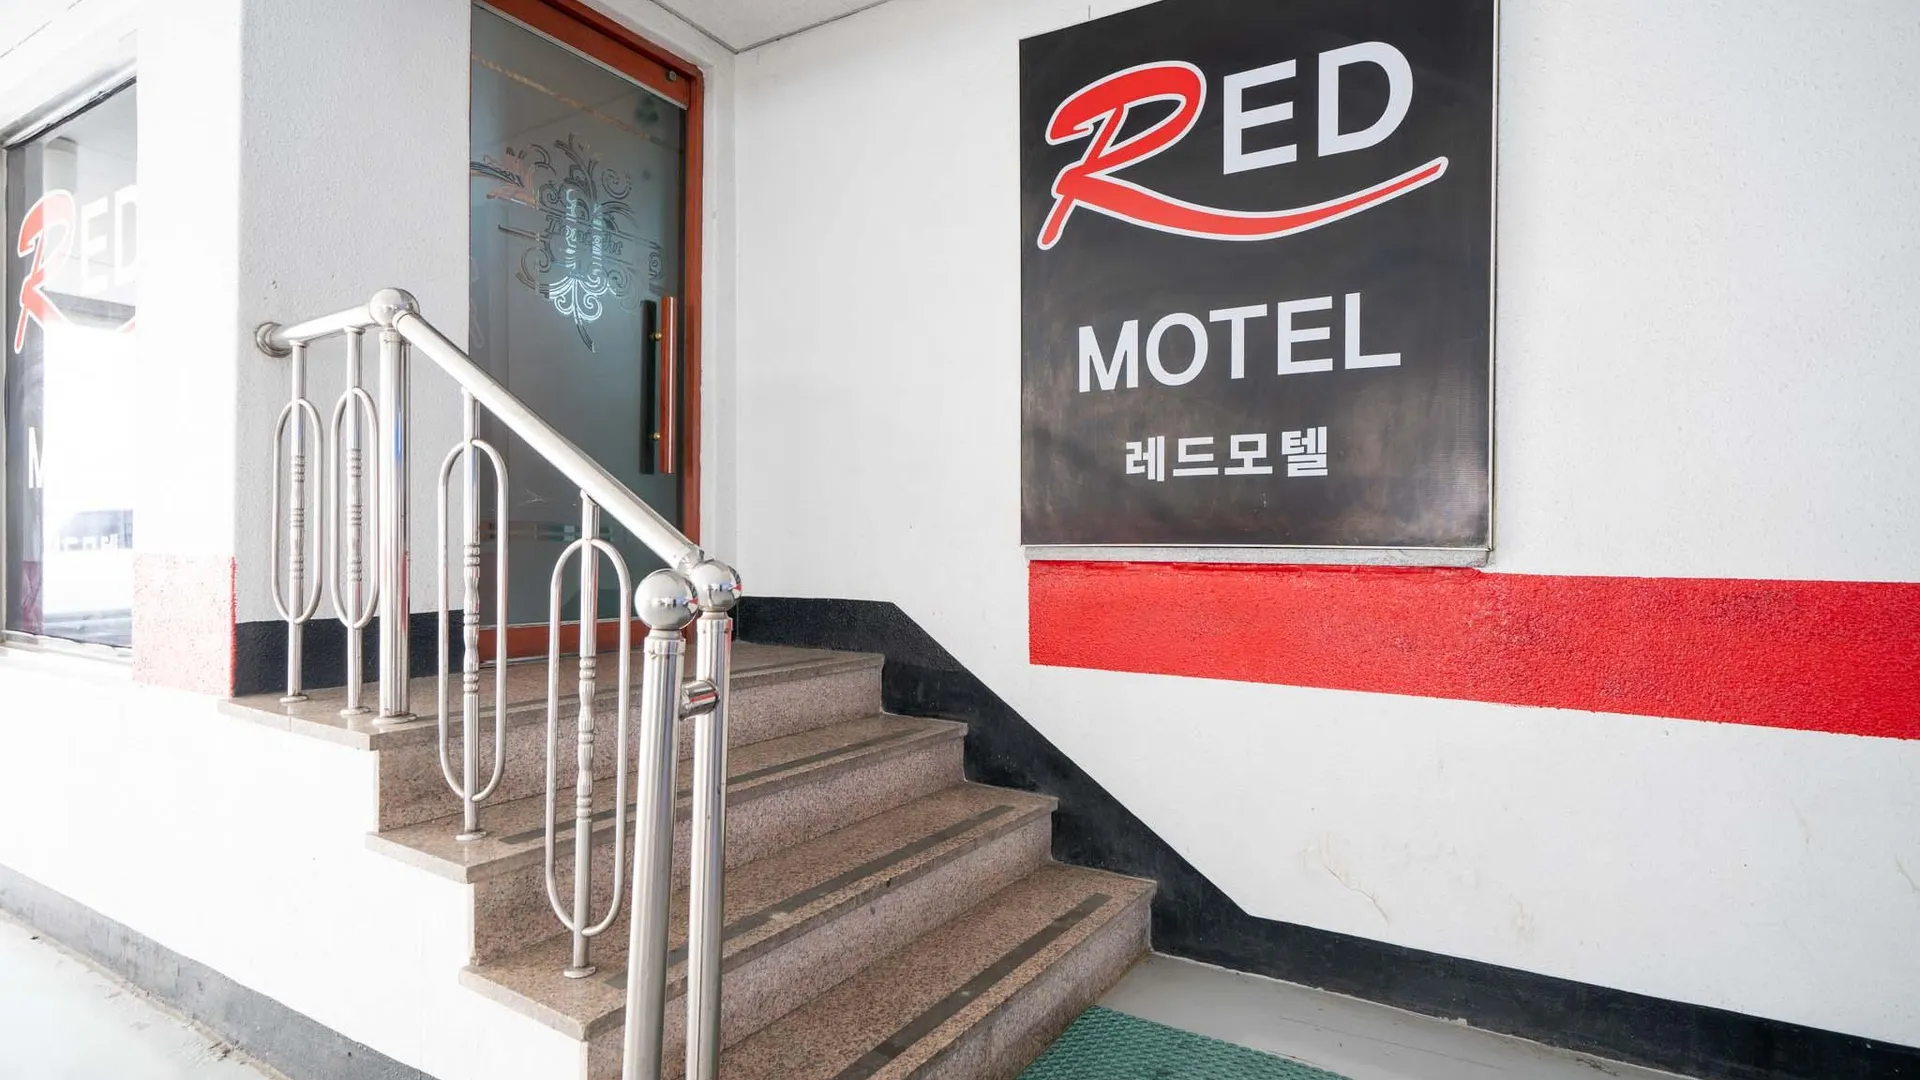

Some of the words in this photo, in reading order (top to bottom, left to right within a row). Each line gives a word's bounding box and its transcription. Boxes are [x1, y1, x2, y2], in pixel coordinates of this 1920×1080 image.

[1037, 40, 1449, 251] RED
[1078, 292, 1401, 393] MOTEL
[1125, 426, 1328, 481] 레드모텔
